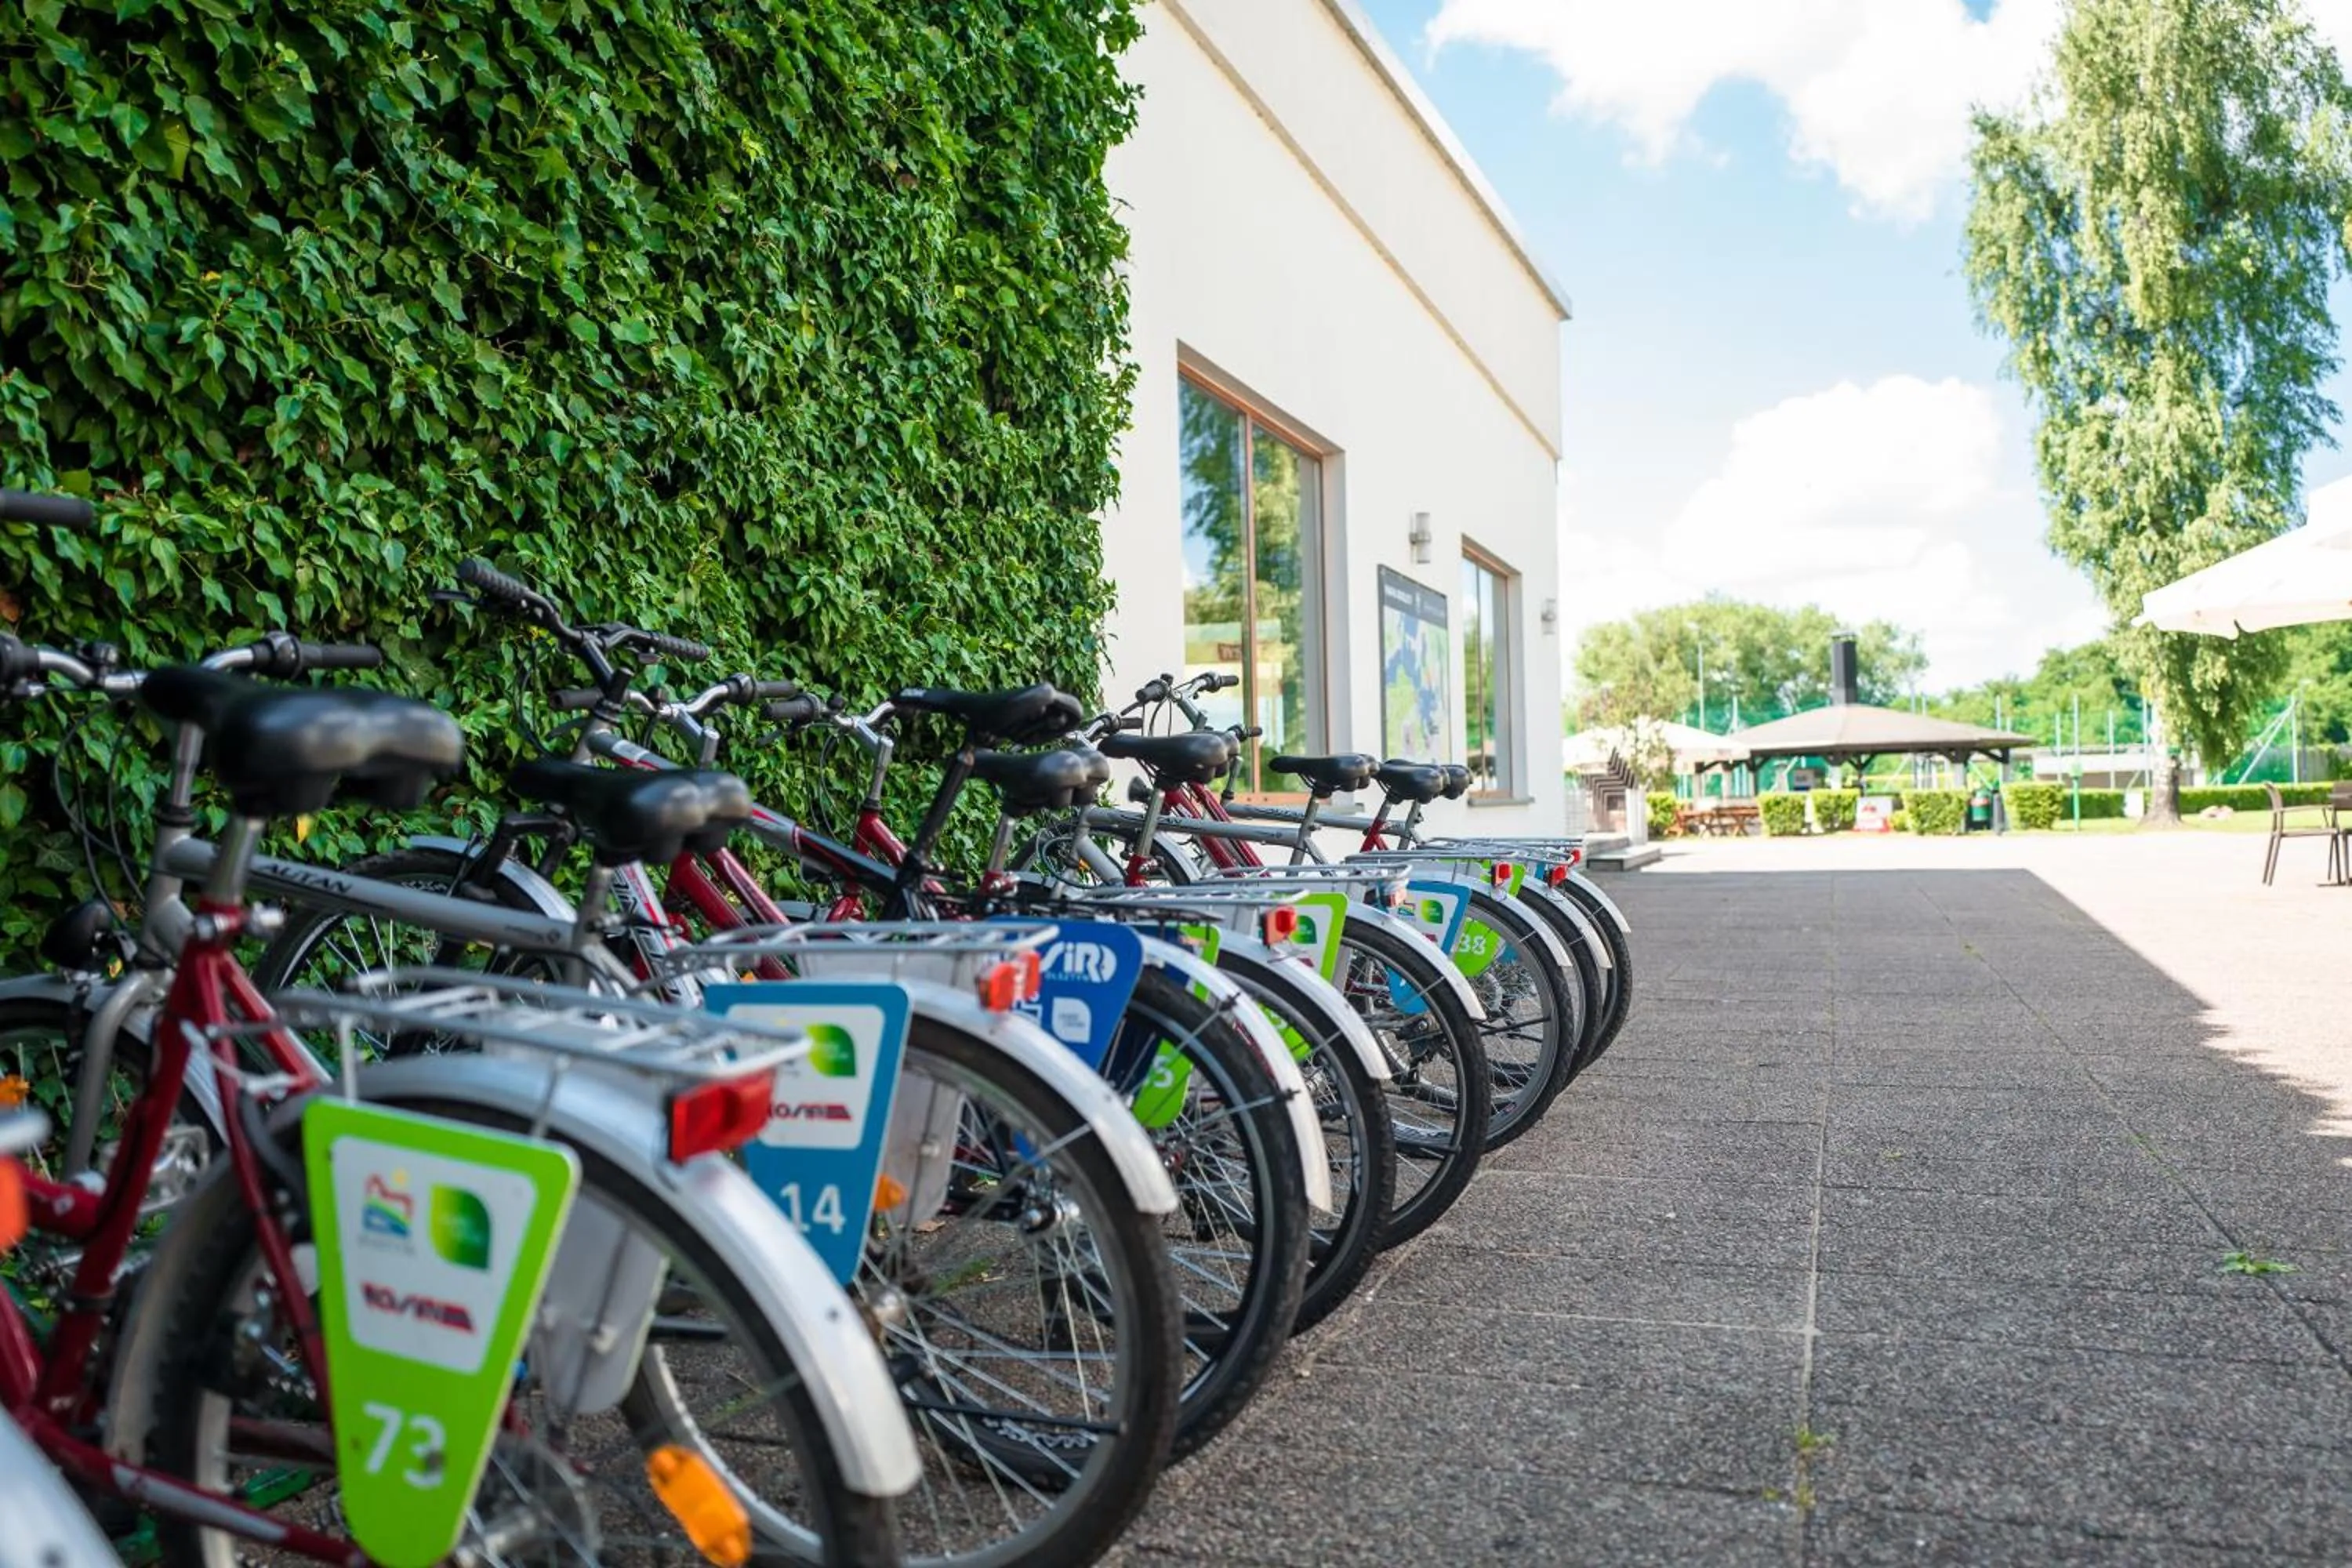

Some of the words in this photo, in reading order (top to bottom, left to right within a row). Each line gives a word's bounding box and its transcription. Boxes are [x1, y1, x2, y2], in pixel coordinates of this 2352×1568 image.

[1145, 1054, 1174, 1088] 5
[780, 1182, 847, 1235] 14
[364, 1401, 447, 1490] 73
